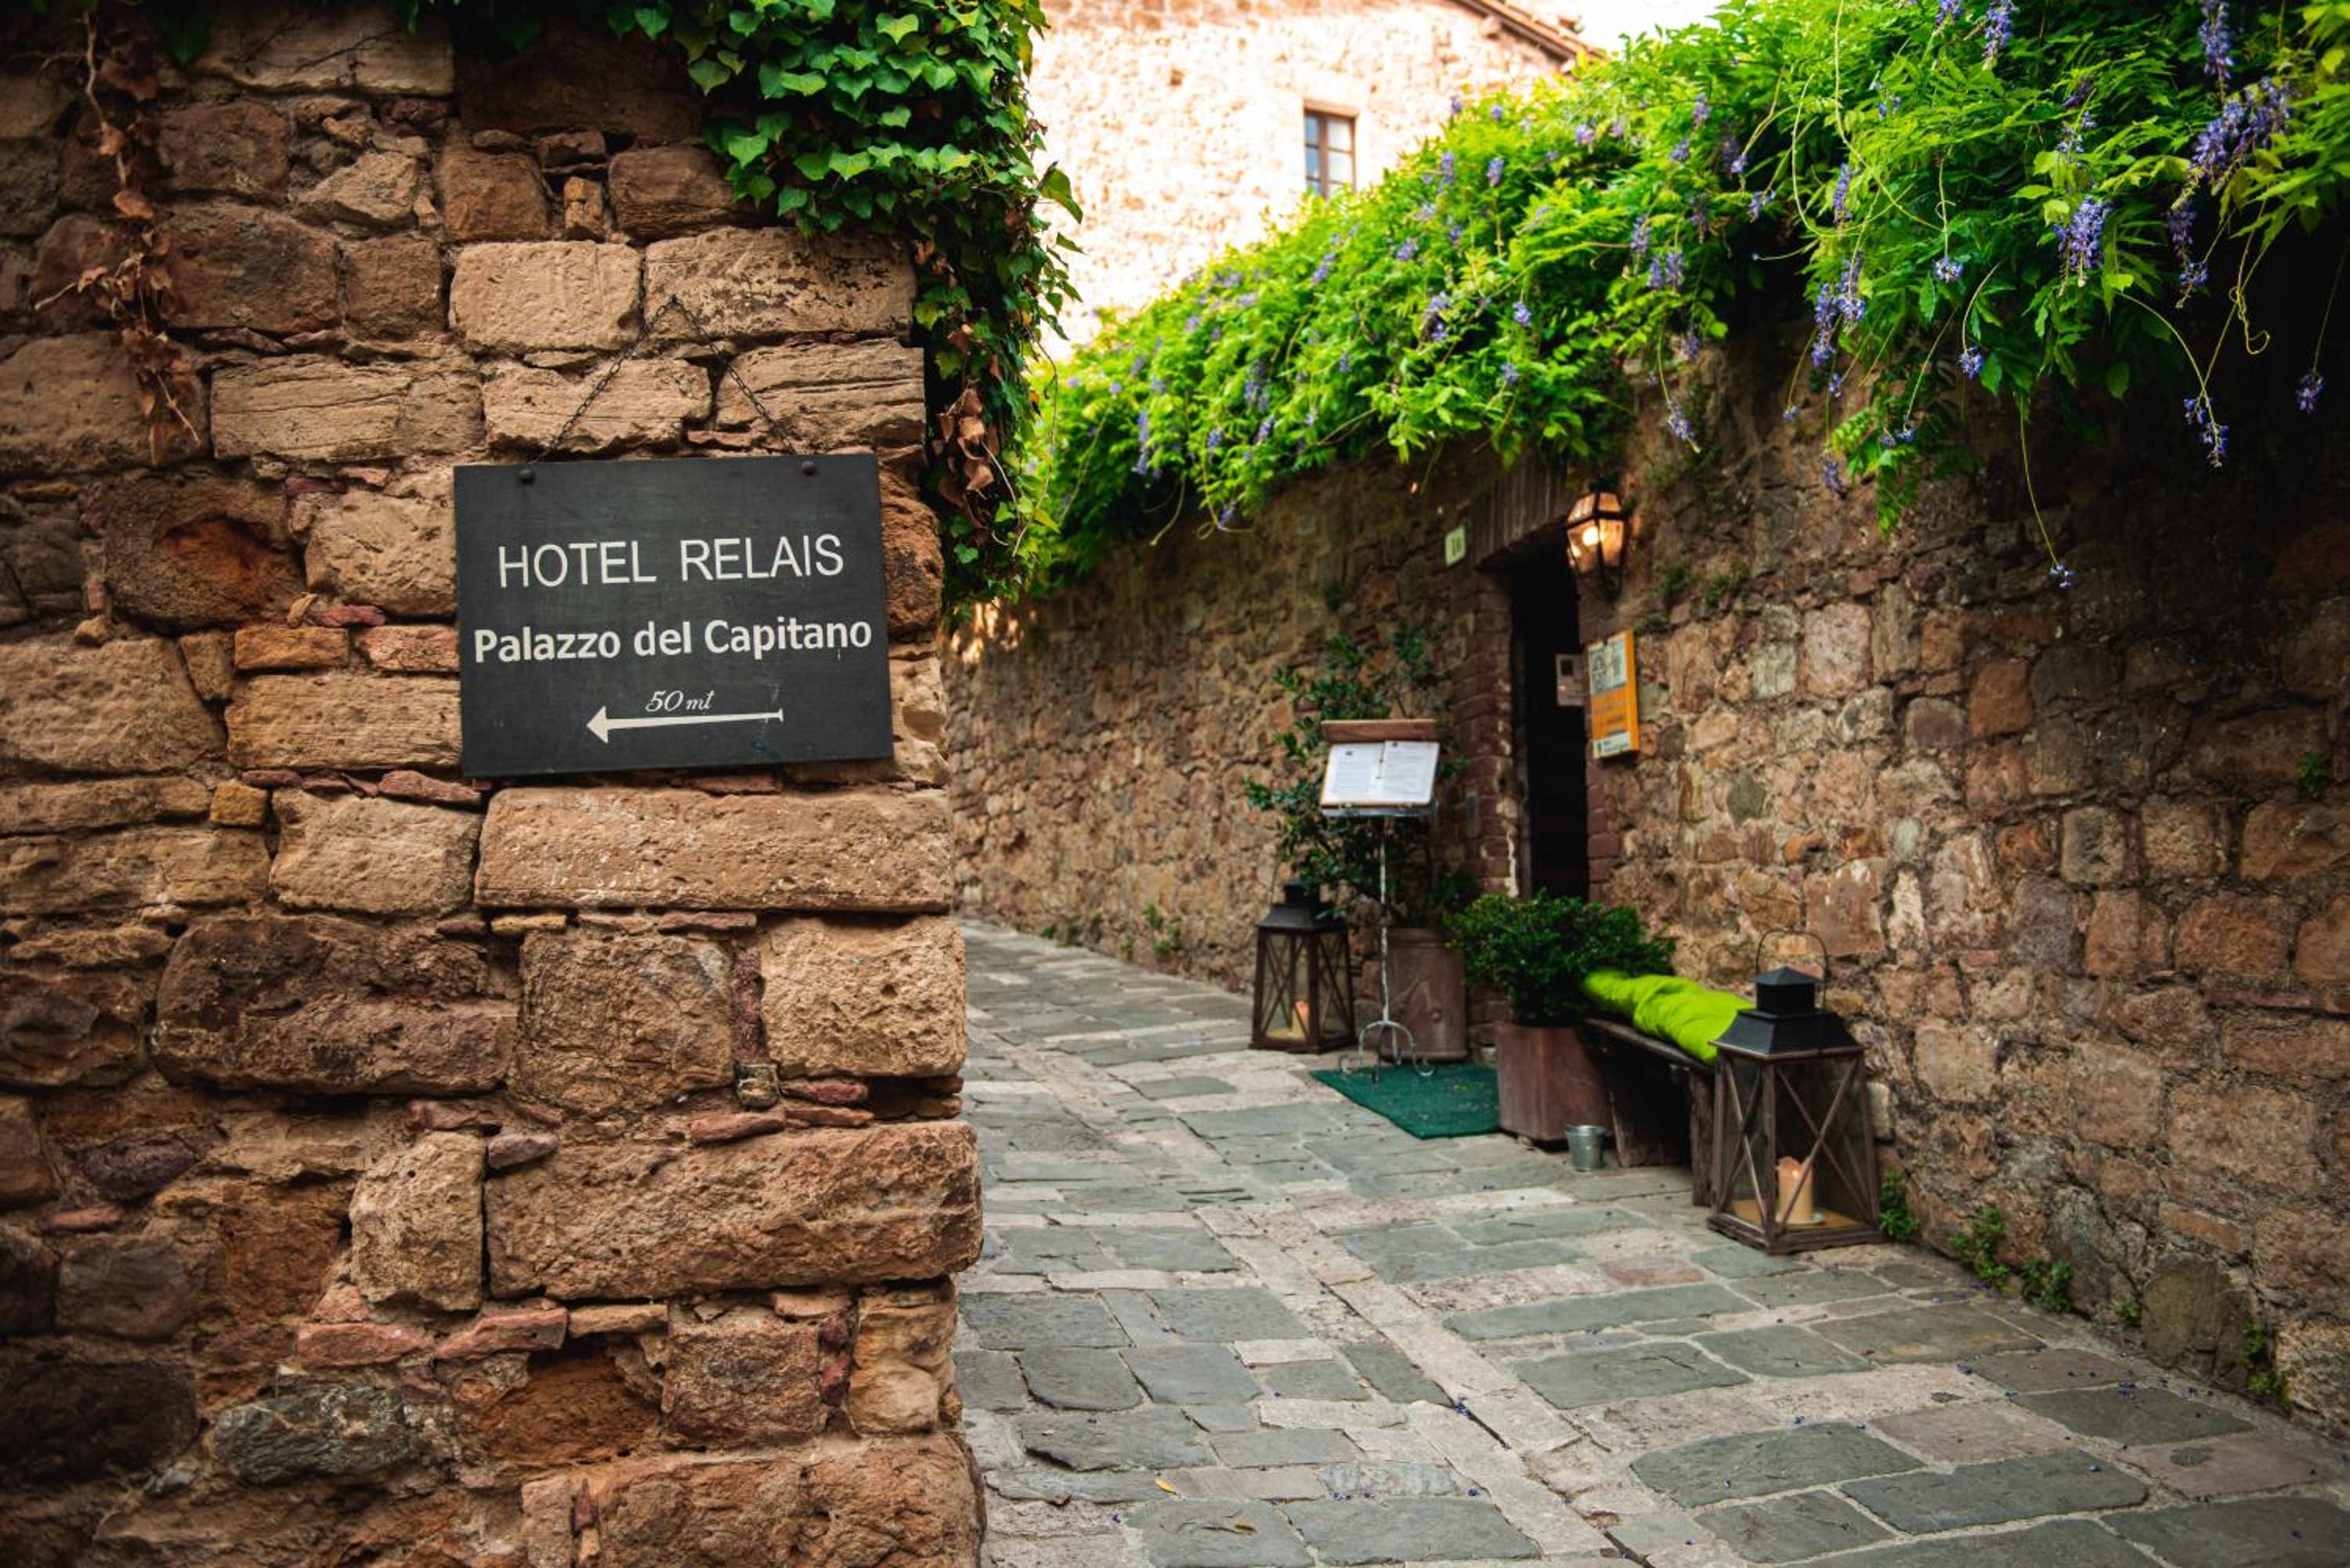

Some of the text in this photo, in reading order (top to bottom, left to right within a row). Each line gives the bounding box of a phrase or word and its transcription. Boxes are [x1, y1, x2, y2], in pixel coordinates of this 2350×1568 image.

[498, 533, 844, 588] HOTEL RELAIS
[474, 616, 873, 663] Palazzo del Capitano
[645, 690, 715, 712] 50 mt
